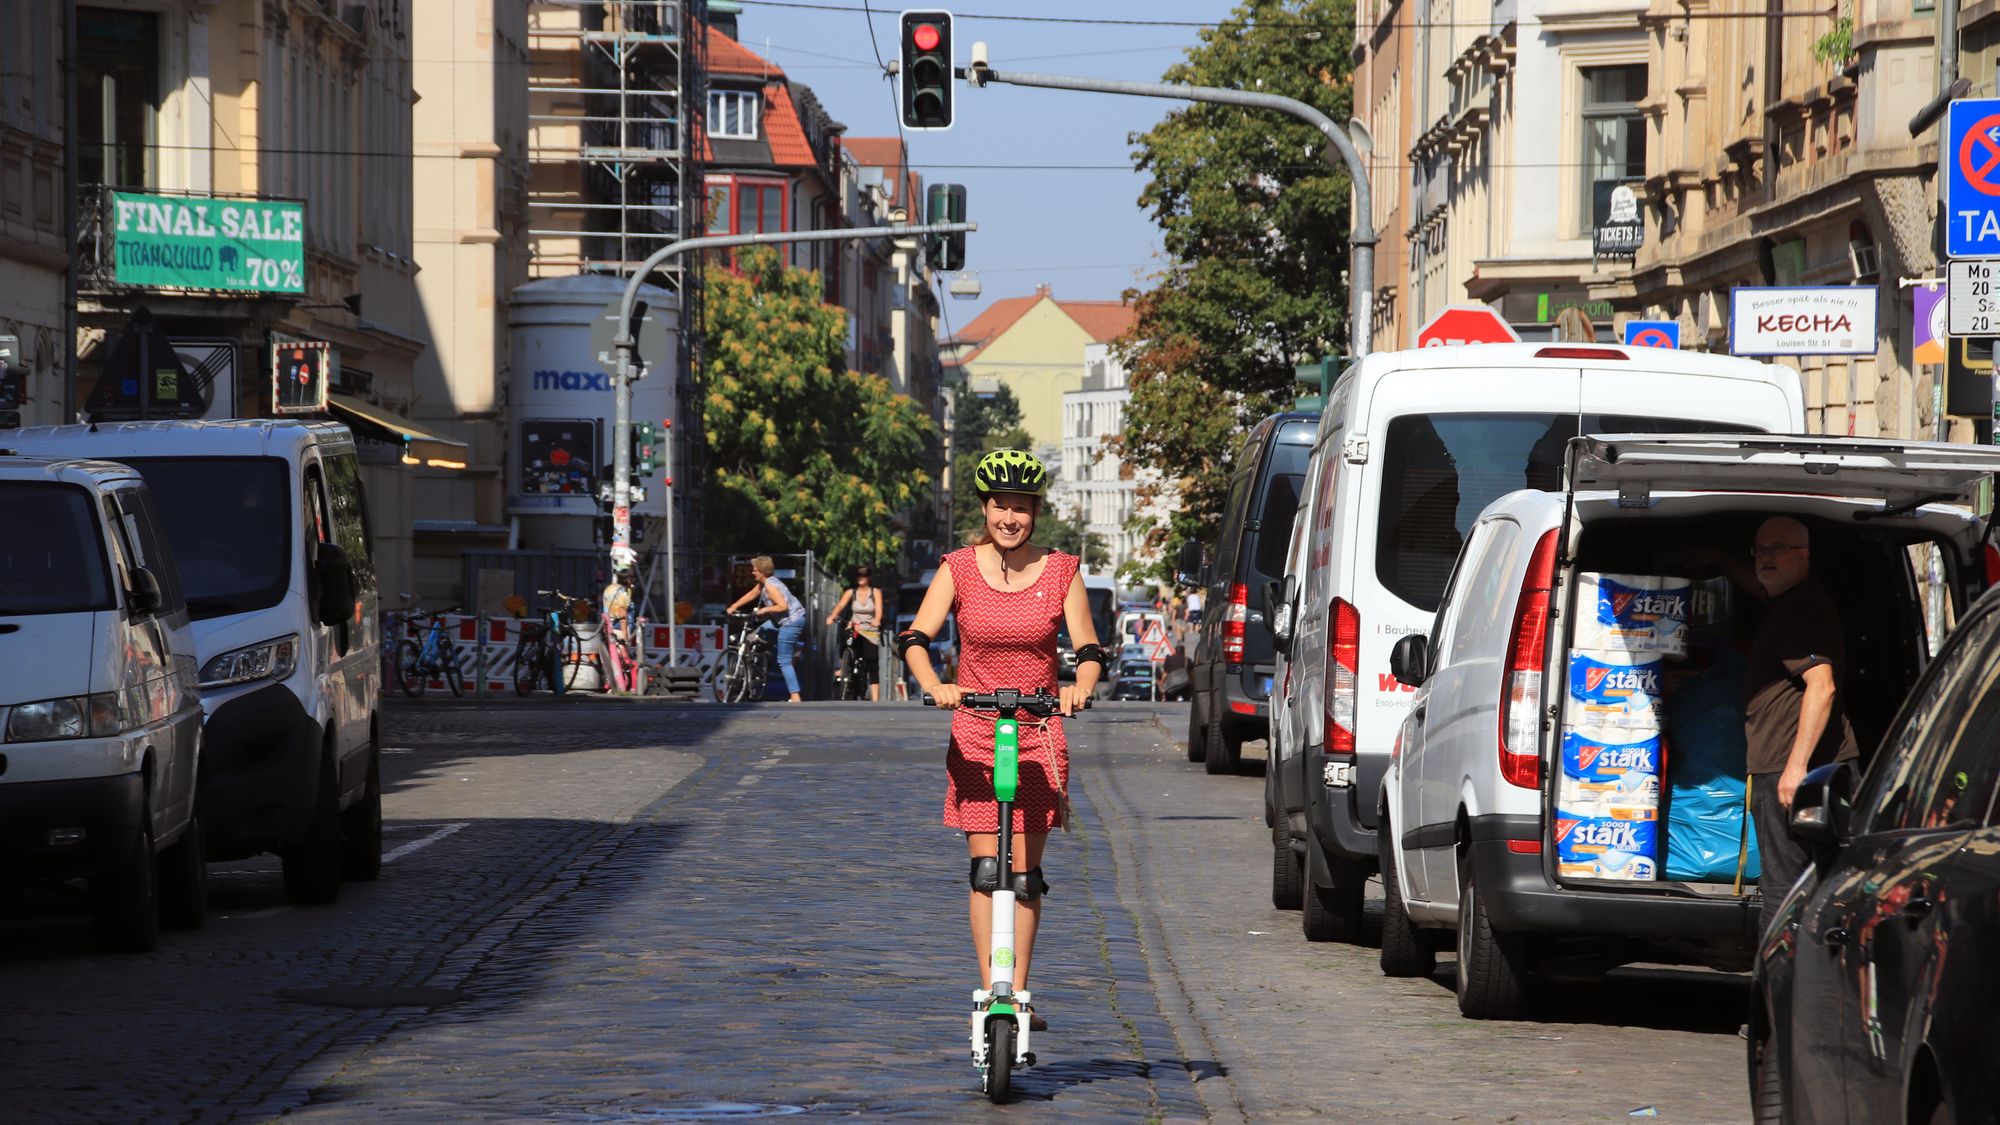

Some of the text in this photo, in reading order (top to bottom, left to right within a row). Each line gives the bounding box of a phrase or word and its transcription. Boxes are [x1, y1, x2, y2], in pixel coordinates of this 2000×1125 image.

[116, 199, 301, 241] FINAL SALE
[1958, 210, 2000, 242] TA
[1599, 226, 1633, 241] TICKETS
[118, 240, 213, 271] TRANQUILLO
[246, 257, 302, 288] 70%
[1968, 264, 1990, 278] Mo
[1972, 281, 1989, 296] 20
[1752, 297, 1784, 310] Besser
[1788, 294, 1810, 305] spät
[1813, 294, 1828, 304] als
[1831, 296, 1844, 306] nie
[1757, 314, 1852, 334] KECHA
[1972, 316, 1988, 331] 20
[1776, 339, 1805, 348] Louisen
[1822, 339, 1831, 347] 51
[1632, 595, 1686, 617] stark
[1605, 669, 1657, 690] stark
[1598, 748, 1652, 768] stark
[1572, 822, 1637, 846] stark
